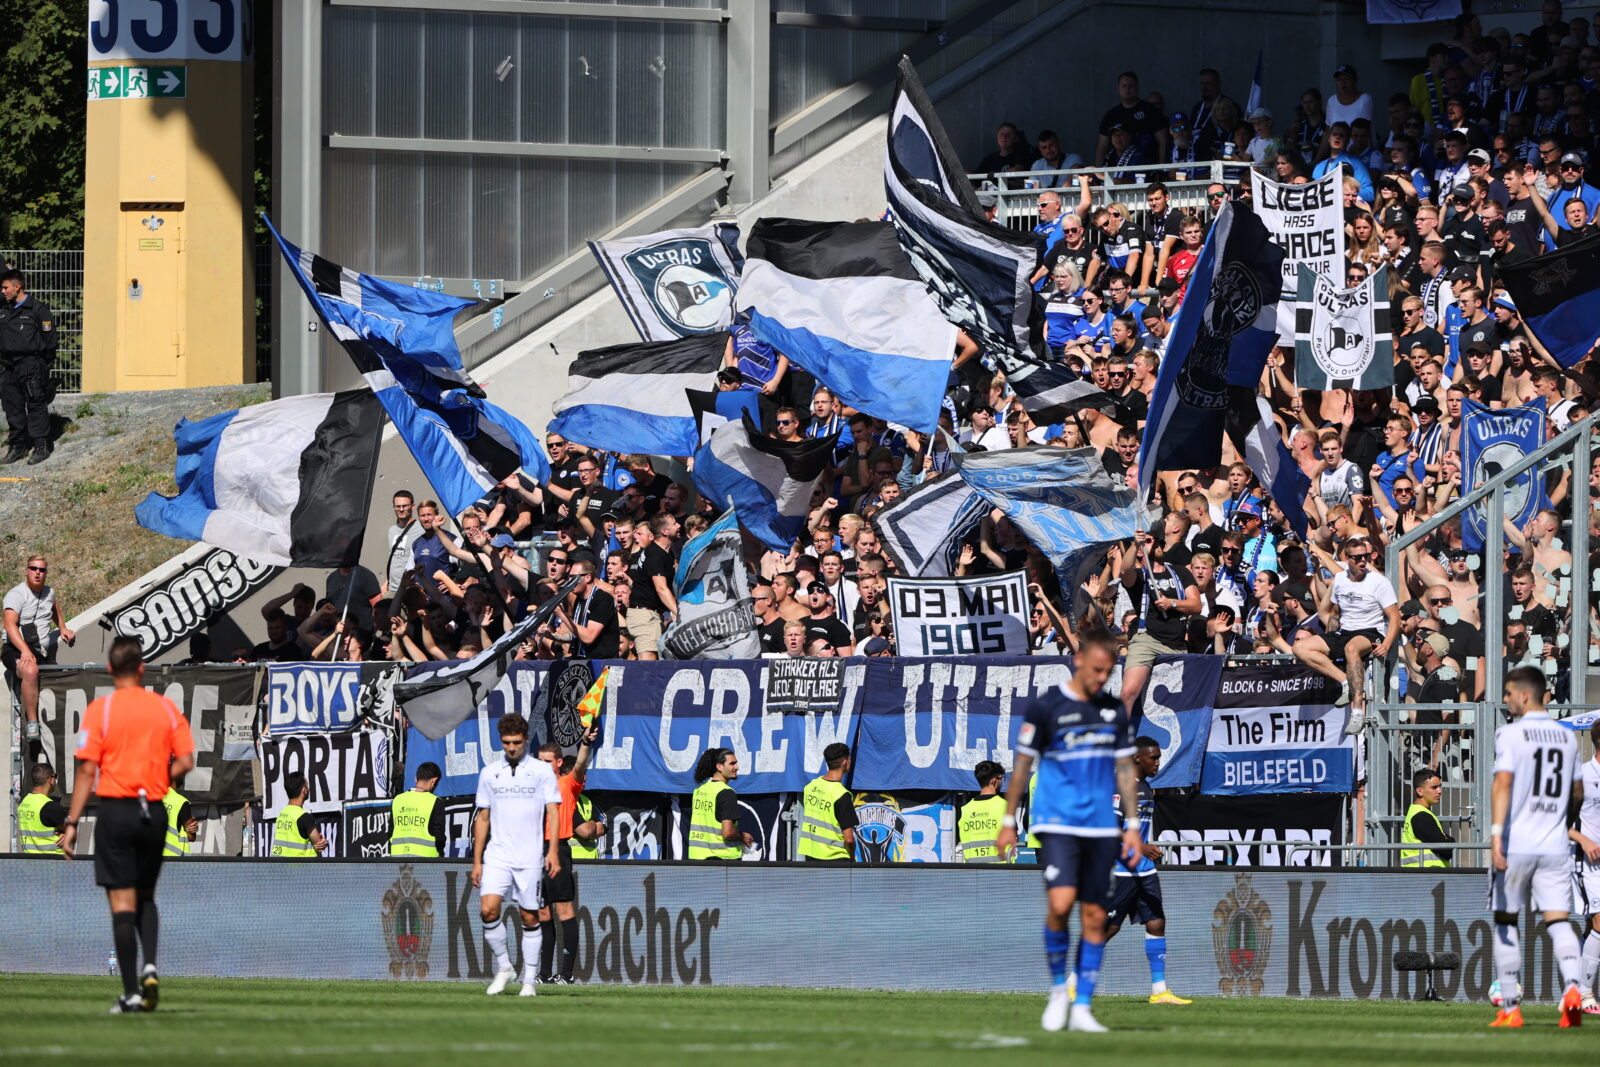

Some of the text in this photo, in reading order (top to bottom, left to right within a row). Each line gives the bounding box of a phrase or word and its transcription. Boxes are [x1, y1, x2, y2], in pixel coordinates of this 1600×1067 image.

[1261, 178, 1334, 212] LIEBE
[1283, 214, 1316, 228] HASS
[636, 246, 703, 270] ULTRAS
[1268, 228, 1336, 260] HAOS
[1283, 260, 1331, 277] RUTUR
[692, 282, 707, 298] A
[1347, 335, 1354, 346] A
[1477, 416, 1534, 441] ULTRAS
[900, 583, 1020, 619] 03.MAI
[920, 621, 1006, 656] 1905
[819, 660, 839, 678] ALS
[770, 679, 839, 697] JEDE AUFLAGE
[1222, 677, 1325, 694] BLOCK 6 SINCE 1998
[271, 670, 361, 731] BOYS
[445, 660, 1185, 777] LOL CREW ULTS
[1220, 712, 1326, 746] The Firm
[38, 682, 220, 794] SPE
[262, 731, 377, 811] PORTA
[1224, 758, 1327, 787] BIELEFELD
[1533, 747, 1563, 799] 13
[492, 784, 536, 795] SCHÜCO
[692, 799, 713, 813] DNER
[963, 818, 998, 832] ORDNER
[445, 871, 721, 986] Kobacher
[1287, 880, 1600, 1000] Krombah
